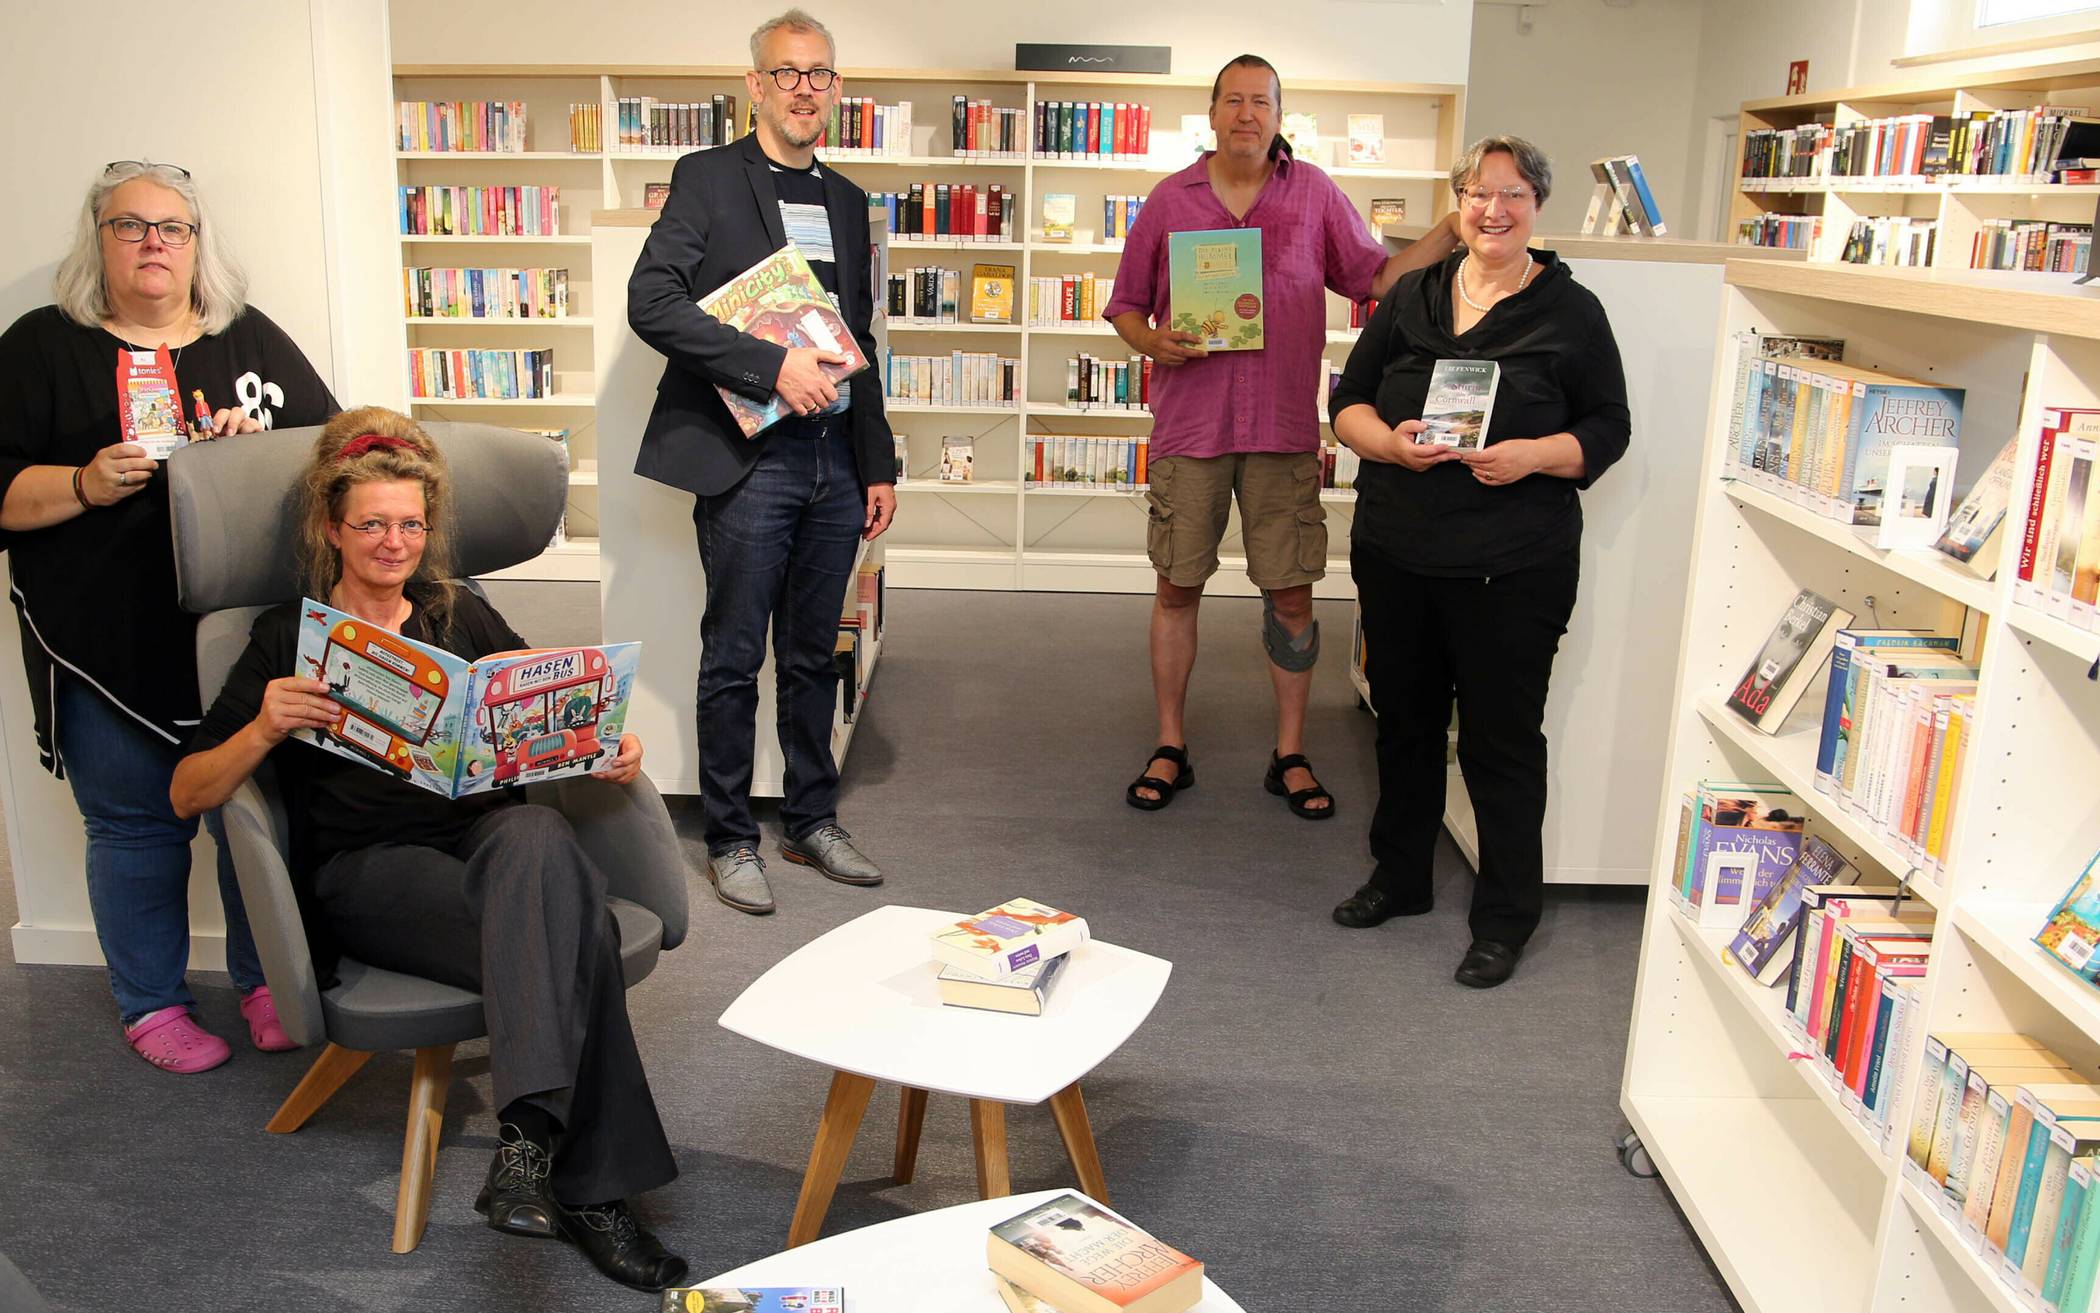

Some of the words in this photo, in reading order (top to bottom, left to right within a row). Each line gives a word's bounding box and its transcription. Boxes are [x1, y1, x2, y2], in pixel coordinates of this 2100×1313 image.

[1064, 286, 1075, 315] WOLFE
[1435, 395, 1476, 405] Cornwall
[1879, 396, 1949, 423] JEFFREY
[1727, 400, 1746, 450] ARCHER
[1864, 410, 1956, 438] ARCHER
[2078, 422, 2100, 433] Ann
[2041, 438, 2051, 462] wer
[2031, 465, 2046, 517] schließlich
[2025, 517, 2037, 544] sind
[2020, 544, 2032, 569] Wir
[1782, 610, 1812, 632] Berkel
[1792, 594, 1828, 623] Christian
[520, 656, 574, 680] HASEN
[553, 667, 575, 681] BUS
[1733, 673, 1772, 715] Ada
[557, 760, 571, 768] BEN
[572, 753, 597, 764] MANTLE
[1735, 834, 1777, 845] Nicholas
[1798, 851, 1833, 886] FERRANTE
[1812, 845, 1835, 870] ELENA
[1758, 870, 1774, 878] der
[1836, 958, 1851, 990] NICOLA
[1872, 1054, 1883, 1071] Fried
[1867, 1070, 1881, 1094] Amelie
[1940, 1072, 1967, 1131] GUTSHAUS
[1079, 1239, 1169, 1286] ARCHER
[1113, 1250, 1179, 1292] JEFFREY
